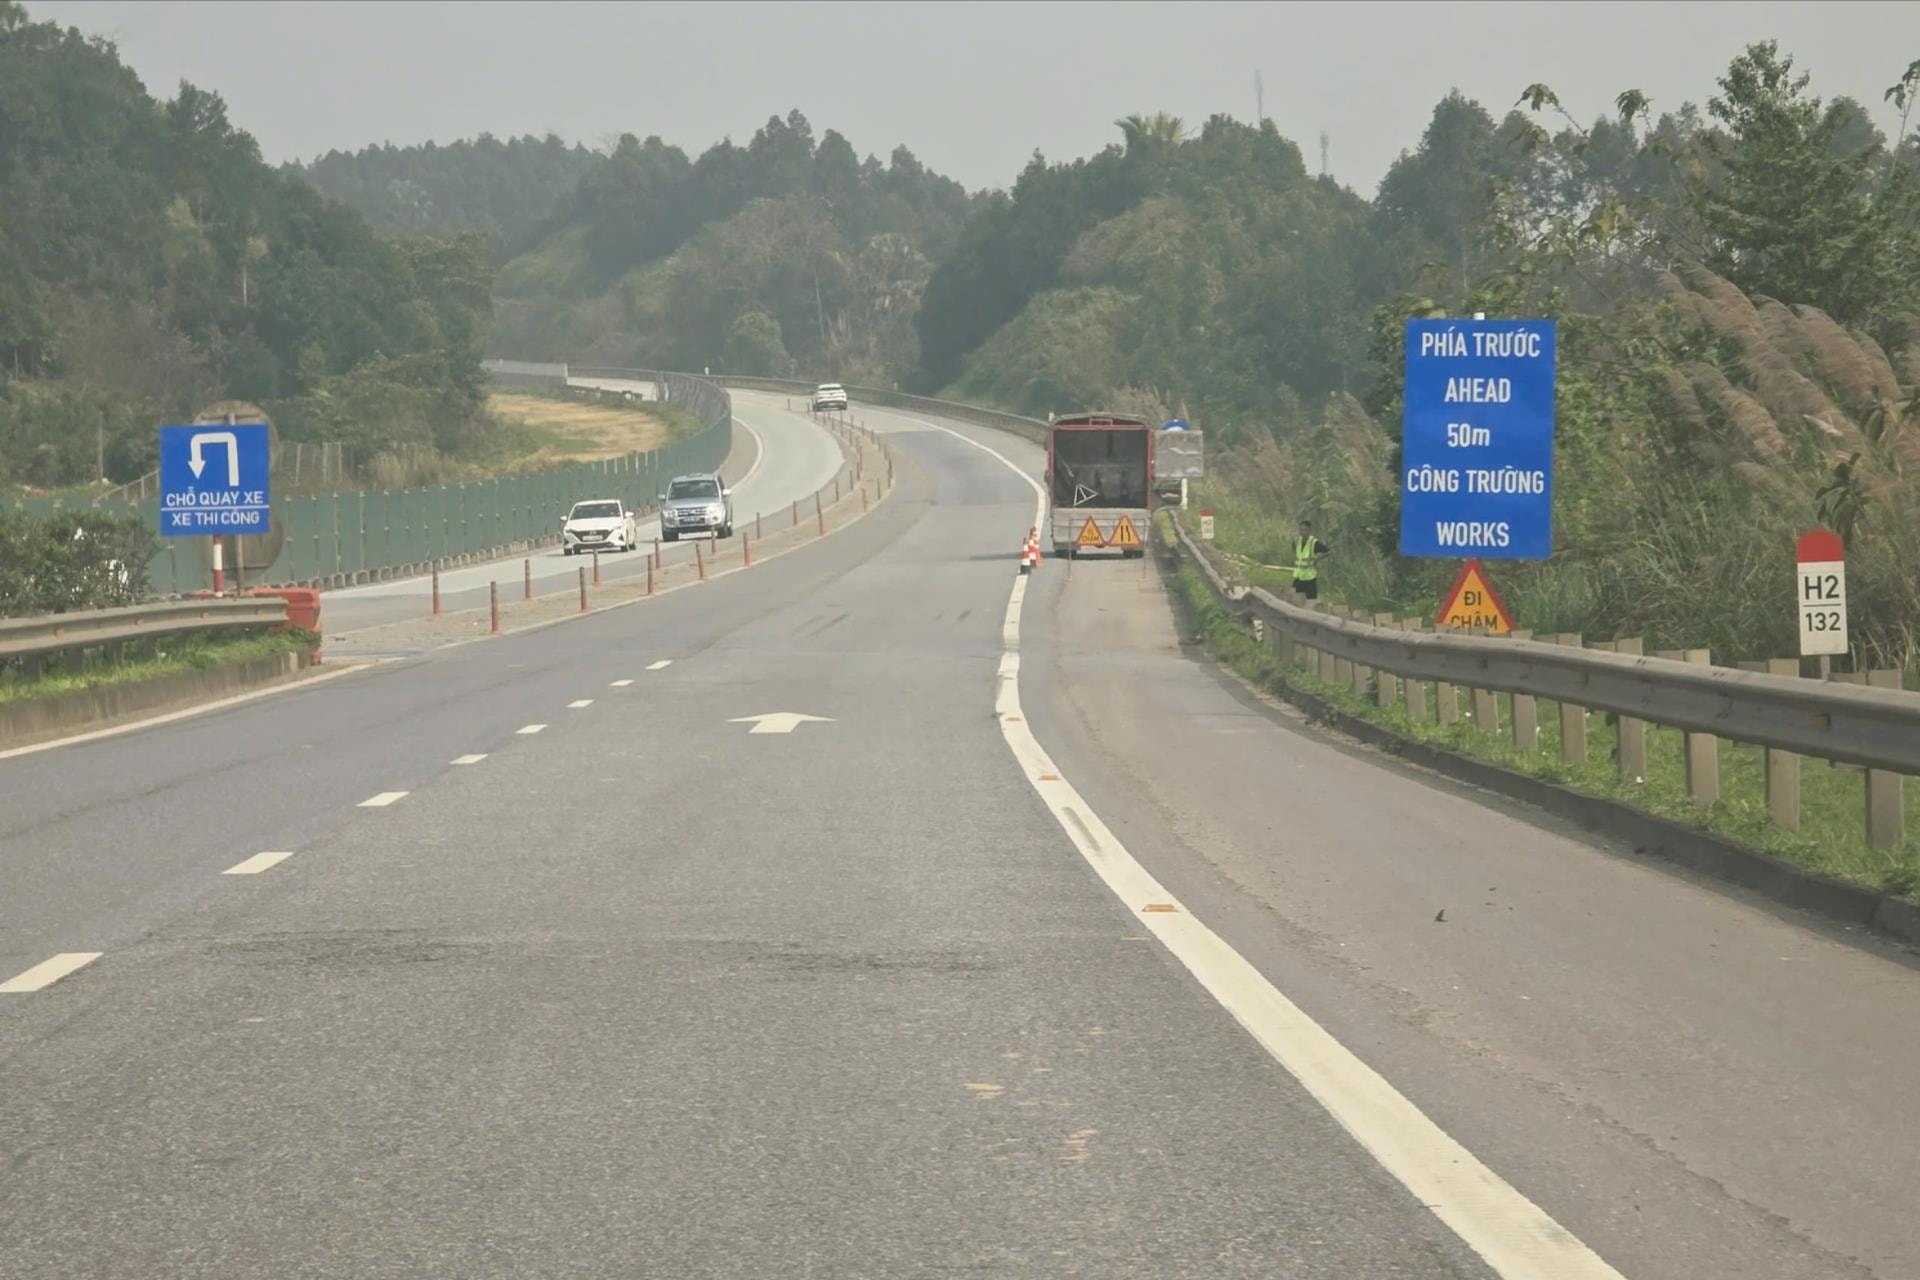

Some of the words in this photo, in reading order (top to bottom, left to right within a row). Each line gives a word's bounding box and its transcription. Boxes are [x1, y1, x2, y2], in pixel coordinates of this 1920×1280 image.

[1420, 326, 1468, 357] PHÍA
[1473, 328, 1541, 358] TRƯỚC
[1444, 378, 1511, 403] AHEAD
[1447, 423, 1490, 448] 50m
[1407, 464, 1459, 493] CÔNG
[1466, 465, 1544, 494] TRƯỜNG
[199, 491, 240, 506] QUAY
[244, 491, 264, 505] XE
[172, 512, 192, 526] XE
[195, 511, 218, 525] THI
[221, 508, 260, 525] CÔNG
[1436, 521, 1510, 547] WORKS
[1463, 590, 1482, 606] ĐI
[1804, 575, 1840, 600] H2
[1805, 612, 1841, 632] 132
